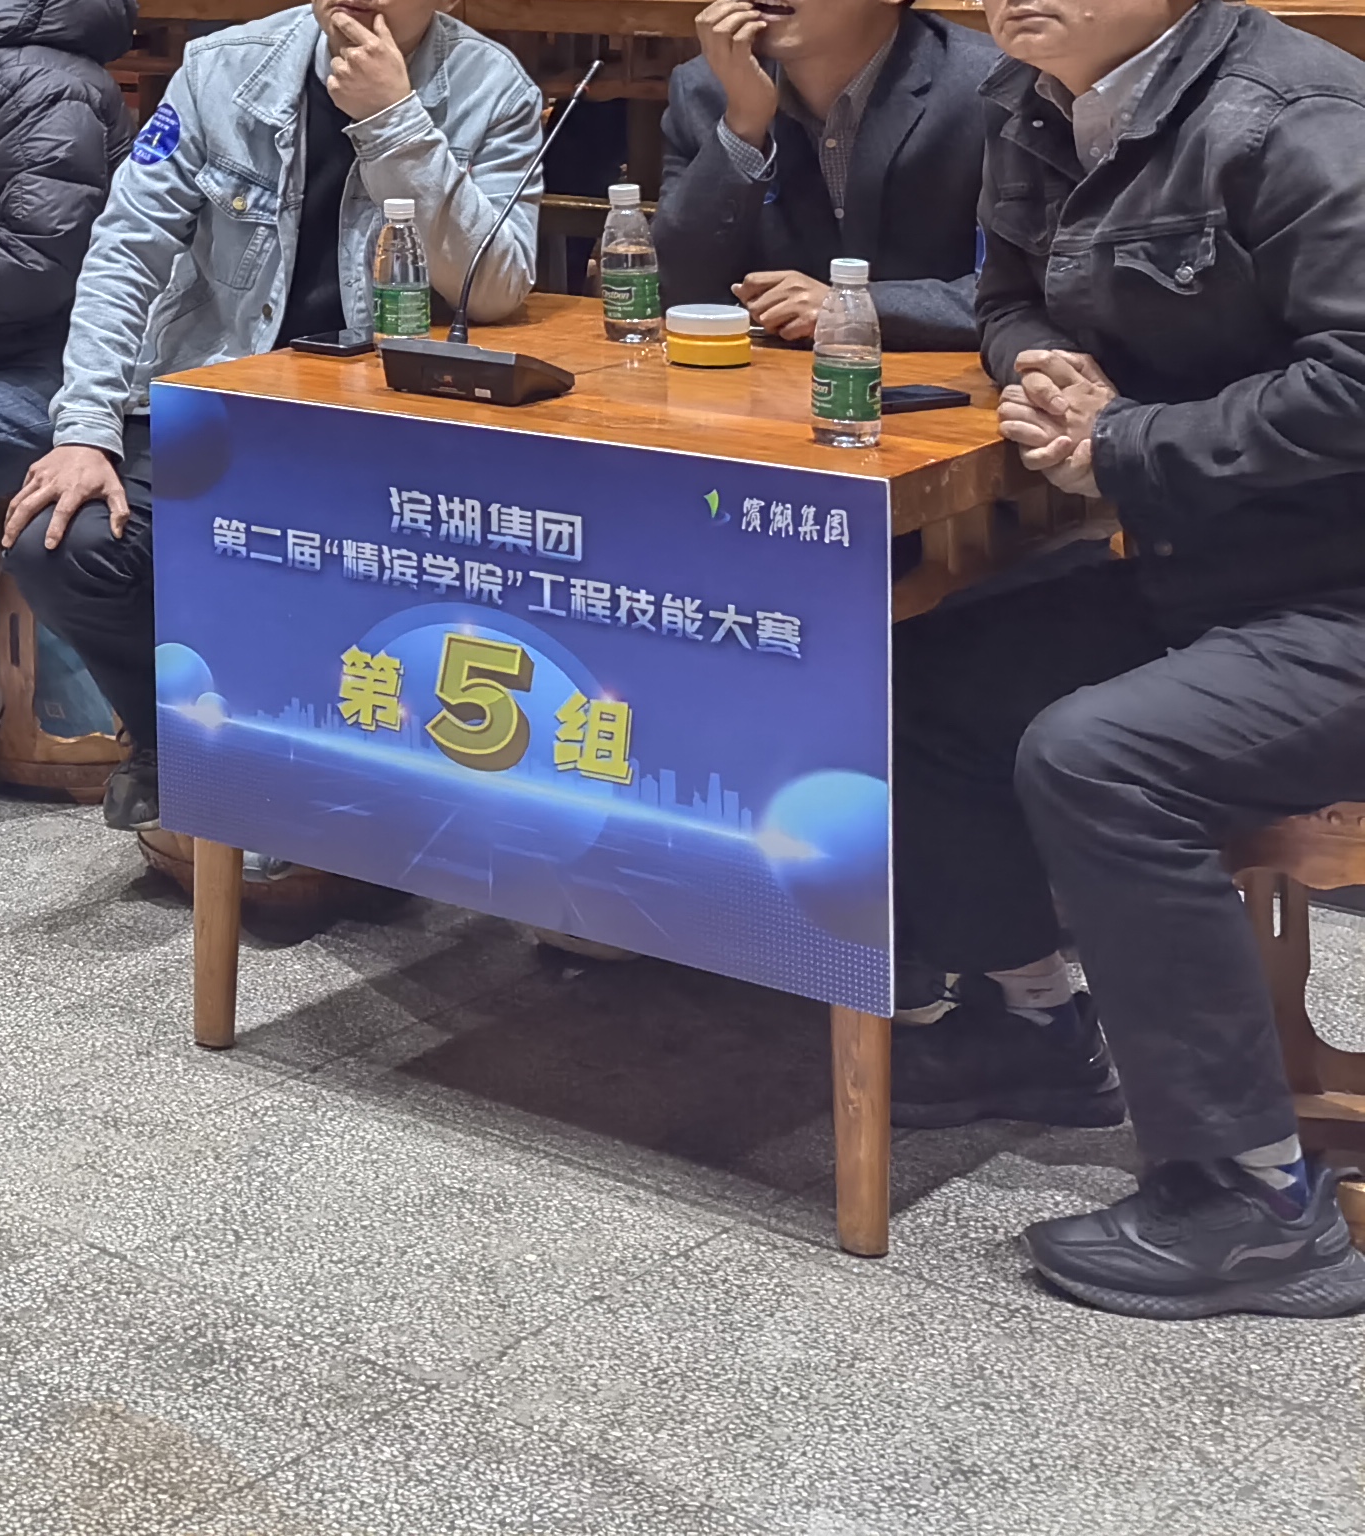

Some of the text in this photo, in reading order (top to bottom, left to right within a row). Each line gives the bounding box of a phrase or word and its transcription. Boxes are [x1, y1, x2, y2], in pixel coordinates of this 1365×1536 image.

[389, 486, 583, 563] 滨湖集团
[338, 630, 633, 785] 第5组
